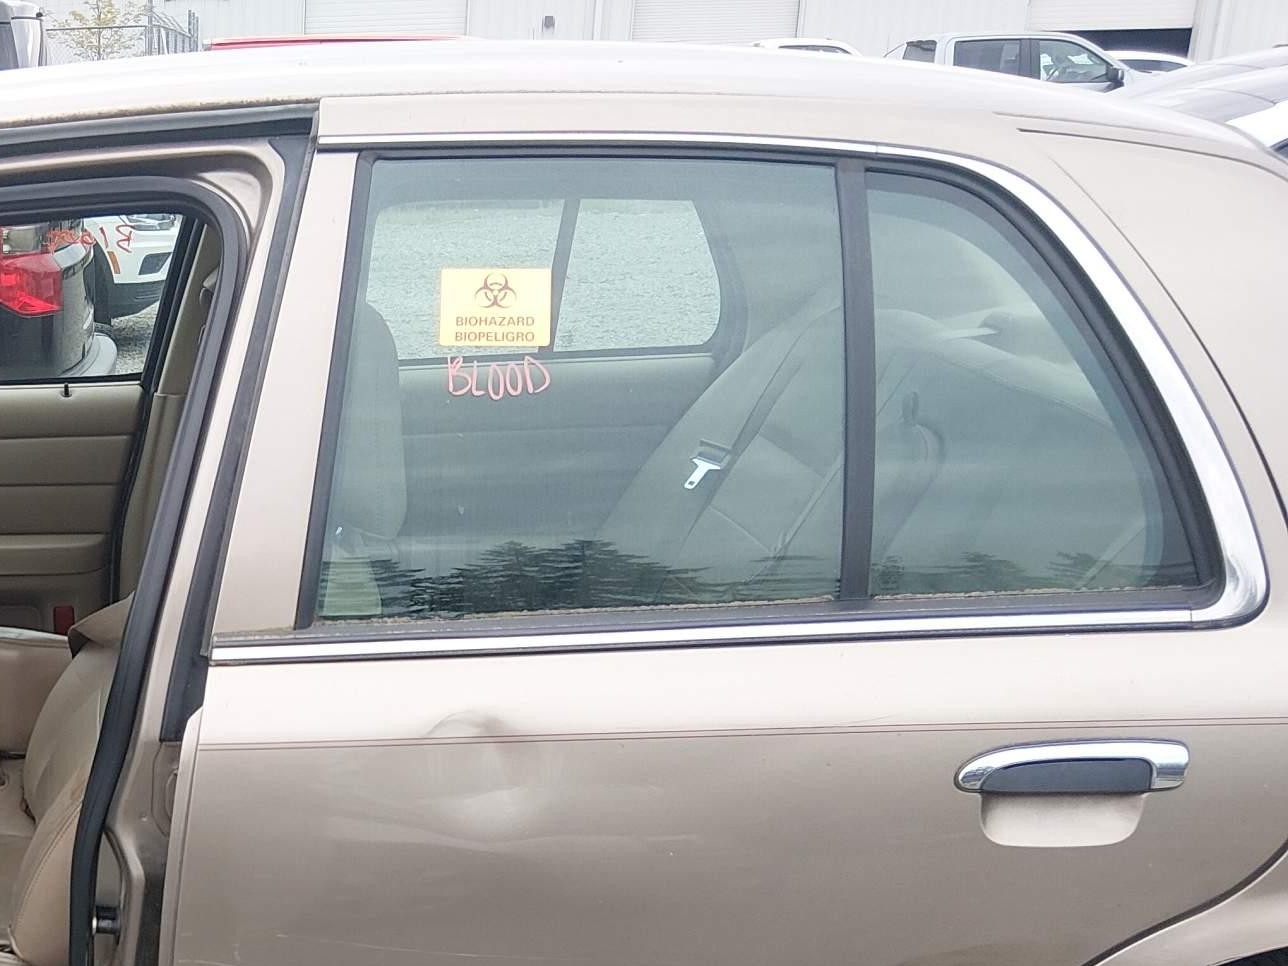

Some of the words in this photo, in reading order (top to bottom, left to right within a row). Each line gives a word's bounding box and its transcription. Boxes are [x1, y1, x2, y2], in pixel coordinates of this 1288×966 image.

[455, 316, 535, 327] BIOHAZARD
[455, 331, 535, 342] BIOPELIGRO
[447, 355, 551, 400] BLOOD
